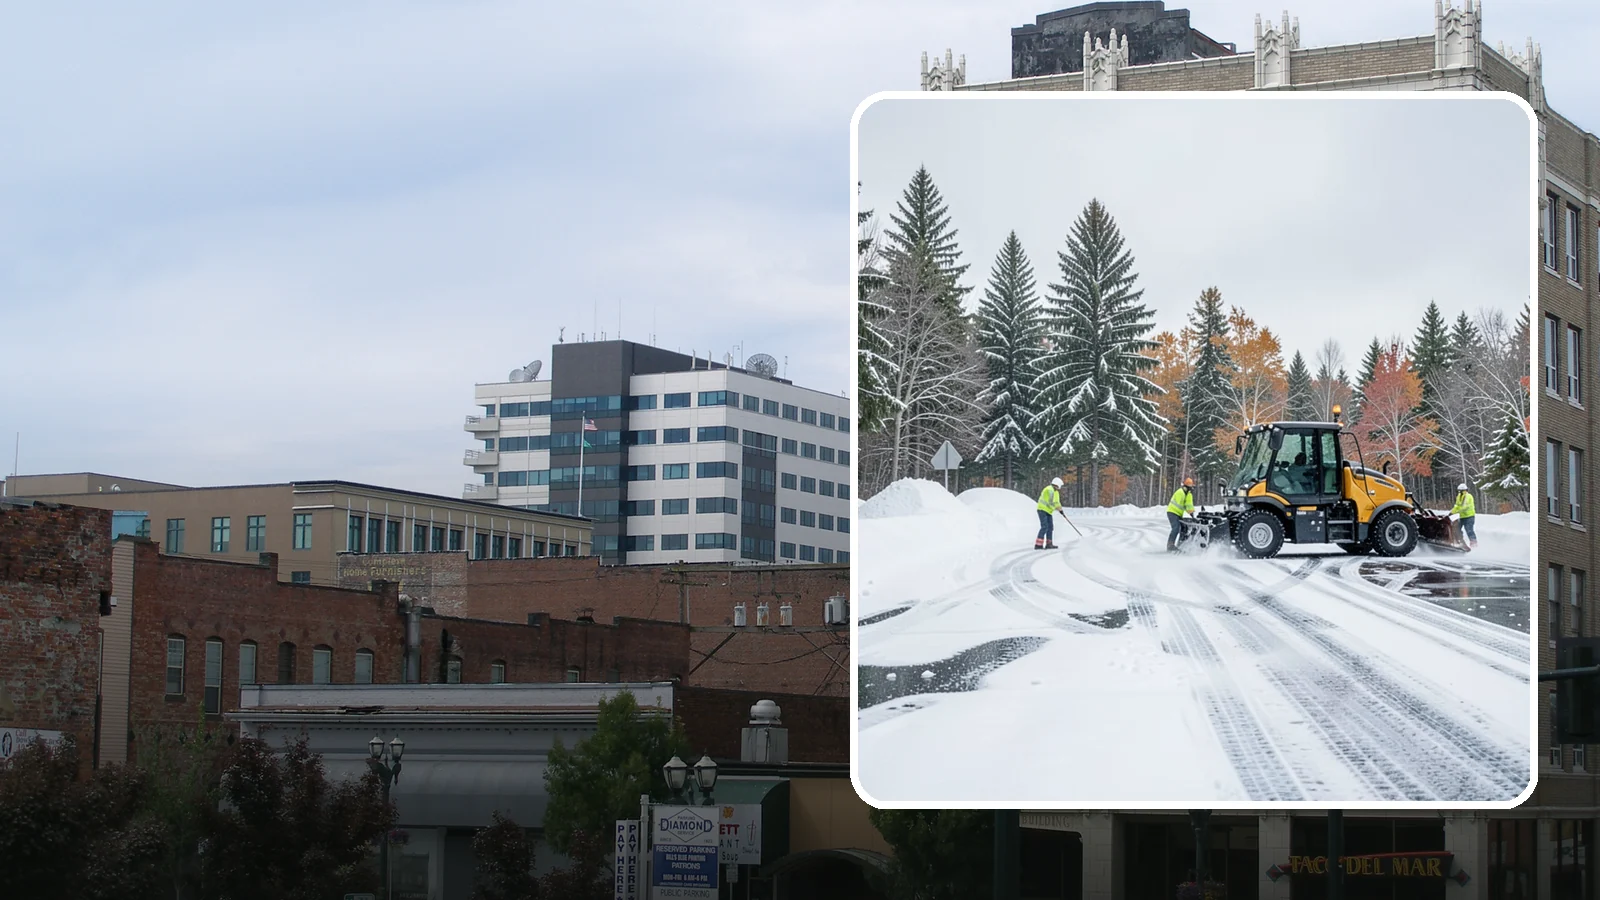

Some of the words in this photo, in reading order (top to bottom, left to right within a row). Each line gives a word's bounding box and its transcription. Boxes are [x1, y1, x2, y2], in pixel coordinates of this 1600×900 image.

[370, 566, 427, 577] Furnishers
[660, 818, 713, 833] DIAMOND
[1022, 815, 1070, 828] BUILDING
[617, 825, 625, 852] PAY
[628, 825, 637, 852] PAY
[656, 845, 688, 853] RESERVED
[689, 846, 716, 854] PARKING
[721, 851, 739, 861] Soup
[672, 862, 701, 870] PATRONS
[1346, 856, 1385, 876] DEL
[1393, 857, 1442, 877] MAR
[616, 856, 625, 893] HERE
[627, 856, 636, 893] HERE
[660, 888, 682, 897] PUBLIC
[684, 889, 710, 898] PARKING
